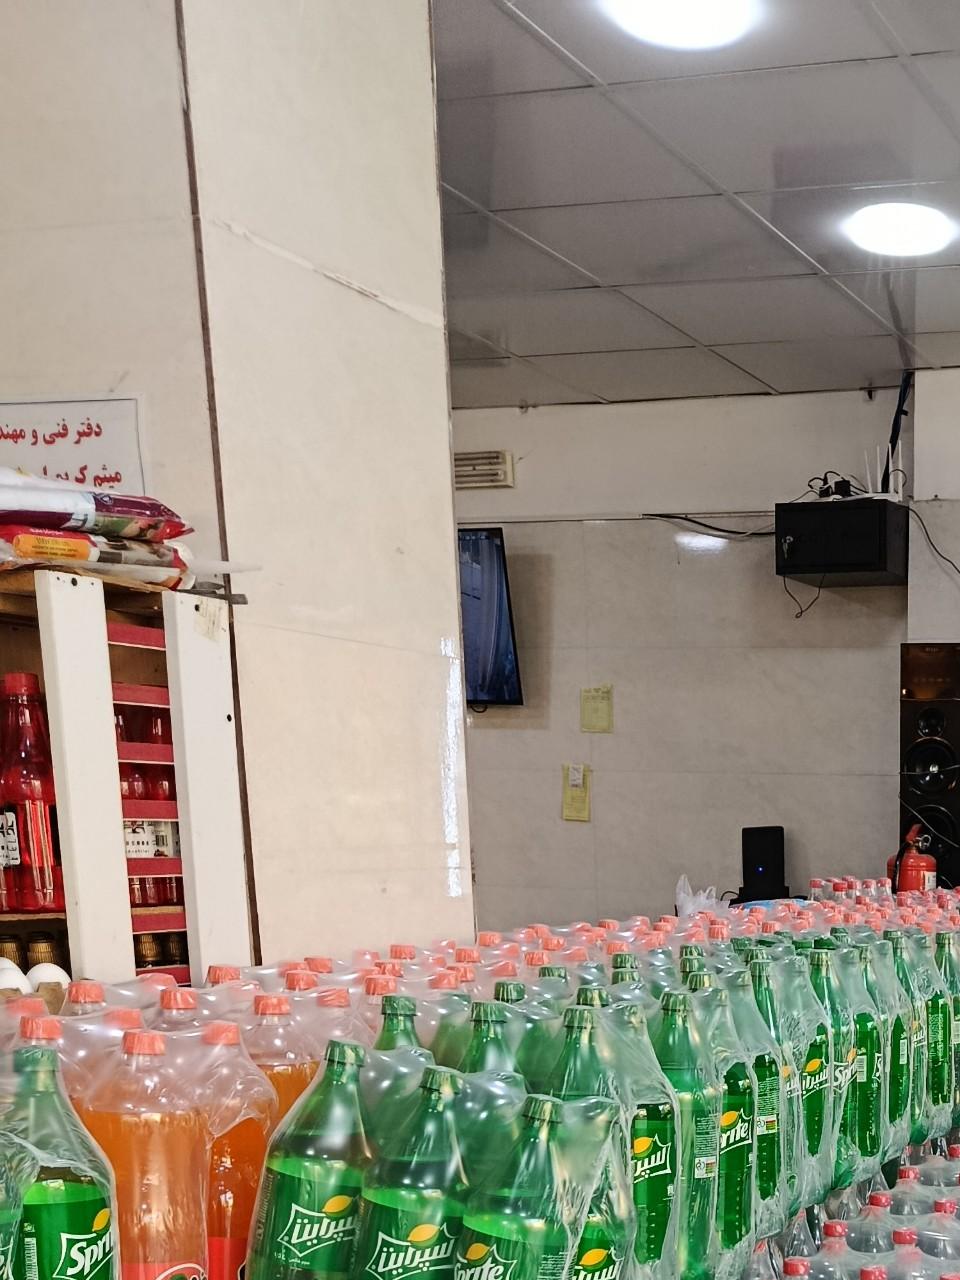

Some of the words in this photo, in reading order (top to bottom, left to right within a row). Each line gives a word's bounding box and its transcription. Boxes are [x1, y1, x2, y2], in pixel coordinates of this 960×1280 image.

[0, 424, 26, 444] مهند
[30, 428, 39, 446] و
[42, 418, 69, 445] فنی
[73, 417, 102, 445] دفتر
[720, 1118, 750, 1149] rite
[65, 1228, 114, 1276] Spri
[377, 1238, 456, 1276] سپرایت
